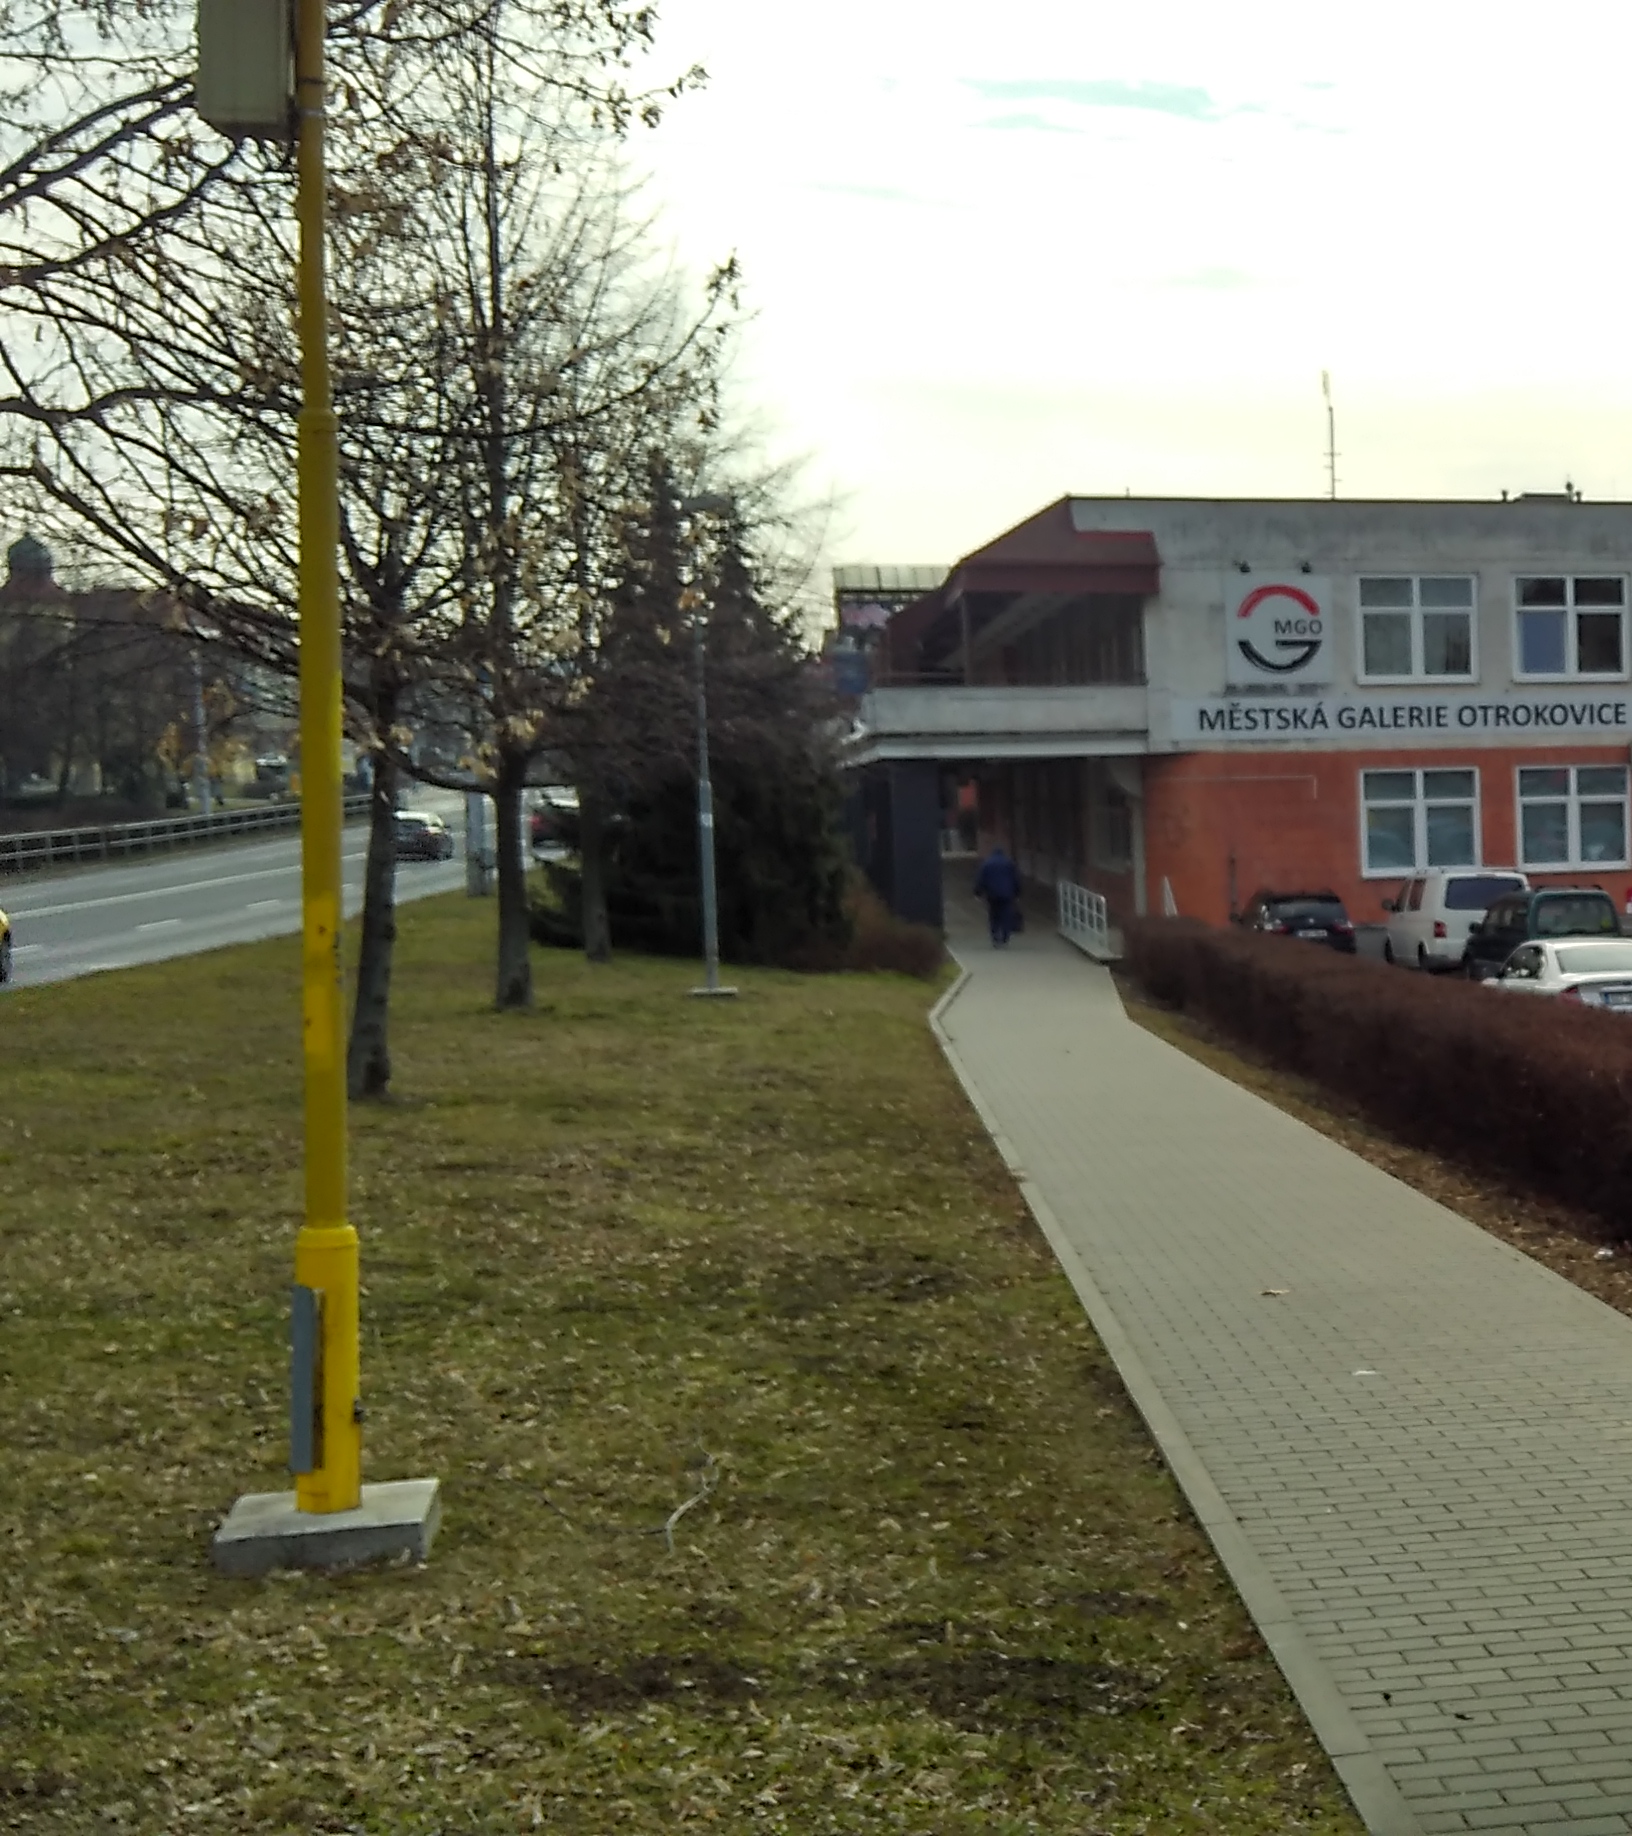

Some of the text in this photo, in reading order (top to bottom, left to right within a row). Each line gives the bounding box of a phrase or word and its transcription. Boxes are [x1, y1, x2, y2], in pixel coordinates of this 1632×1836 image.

[1274, 619, 1323, 635] MGO
[1199, 701, 1628, 731] MĚSTSKÁ GALERIE OTROKOVICE
